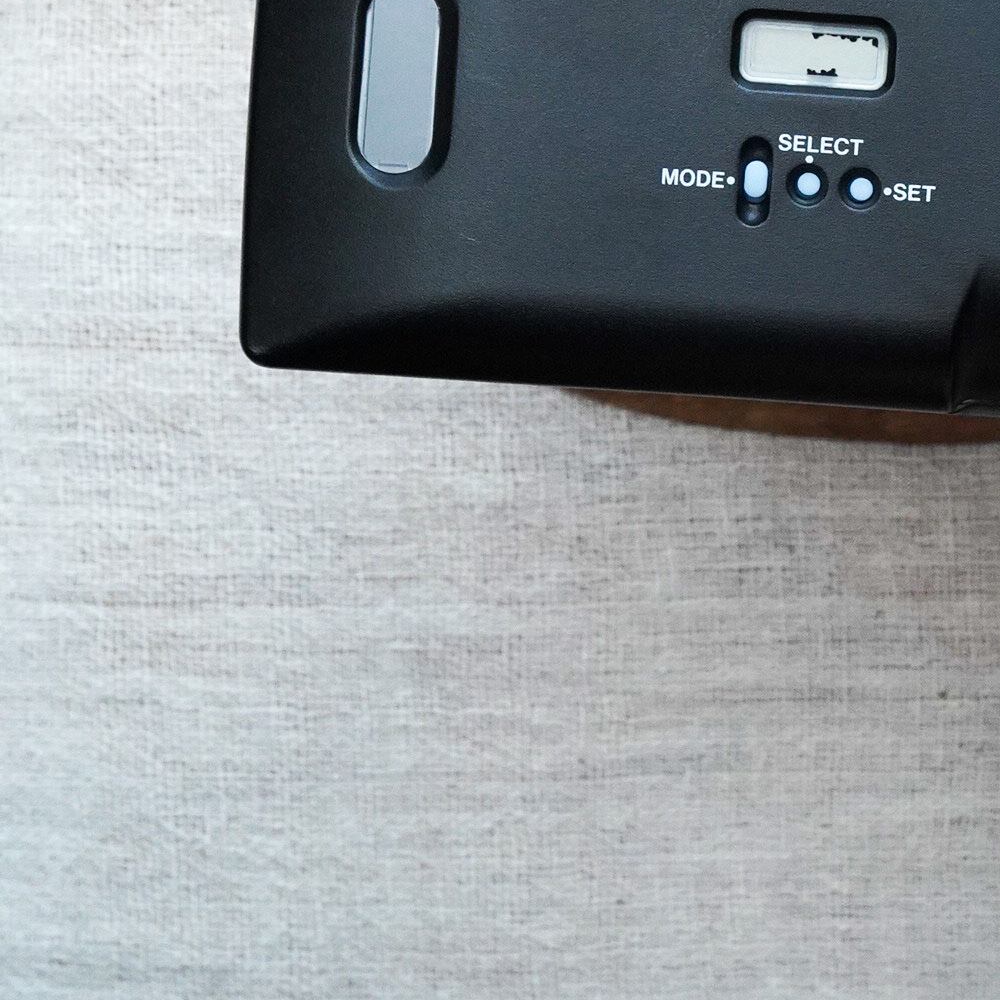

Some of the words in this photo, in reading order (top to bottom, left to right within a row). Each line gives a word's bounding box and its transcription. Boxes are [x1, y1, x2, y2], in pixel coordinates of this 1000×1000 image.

[777, 133, 864, 156] SELECT
[661, 167, 726, 189] MODE
[892, 183, 937, 203] SET
